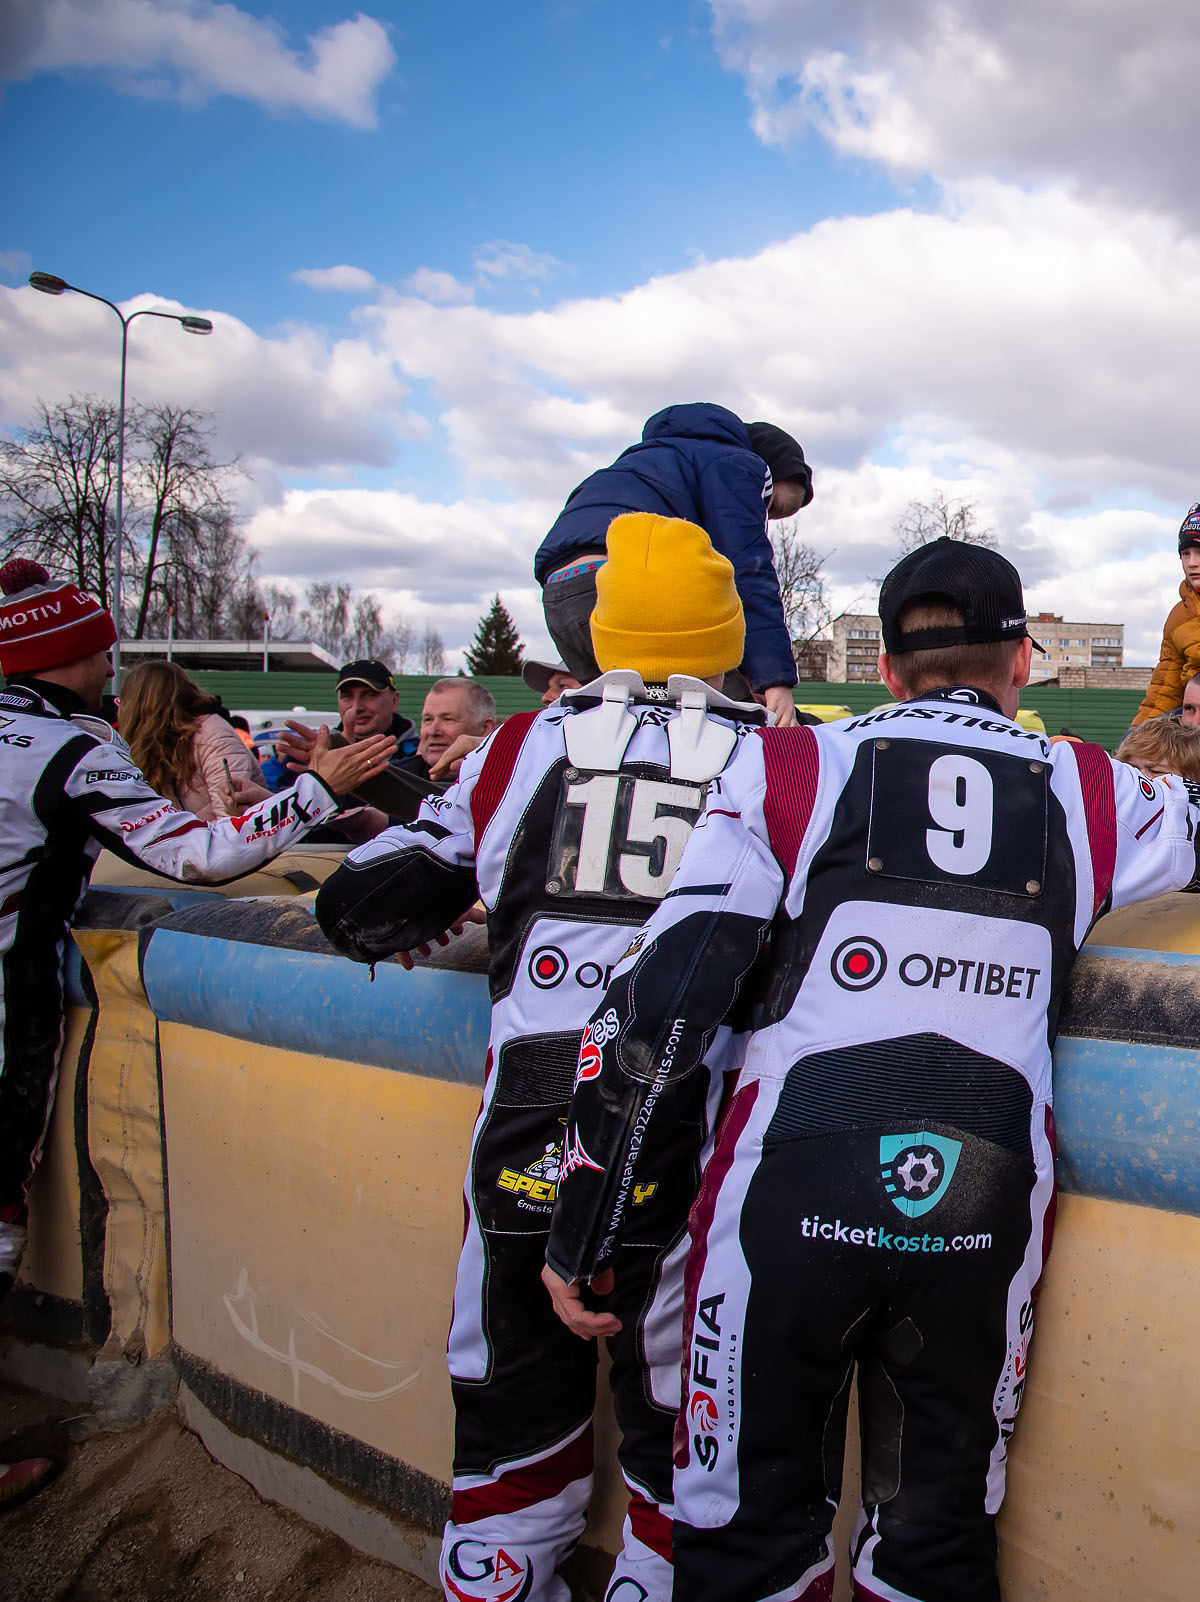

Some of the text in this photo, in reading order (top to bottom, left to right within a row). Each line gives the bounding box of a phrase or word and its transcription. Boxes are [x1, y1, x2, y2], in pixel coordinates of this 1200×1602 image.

[567, 775, 702, 898] 15
[926, 754, 994, 875] 9
[899, 953, 1041, 1000] OPTIBET
[608, 1017, 686, 1231] www.qatar2022events.com
[800, 1215, 993, 1252] ticketkosta.com
[727, 1334, 737, 1443] DAUGAVPILS
